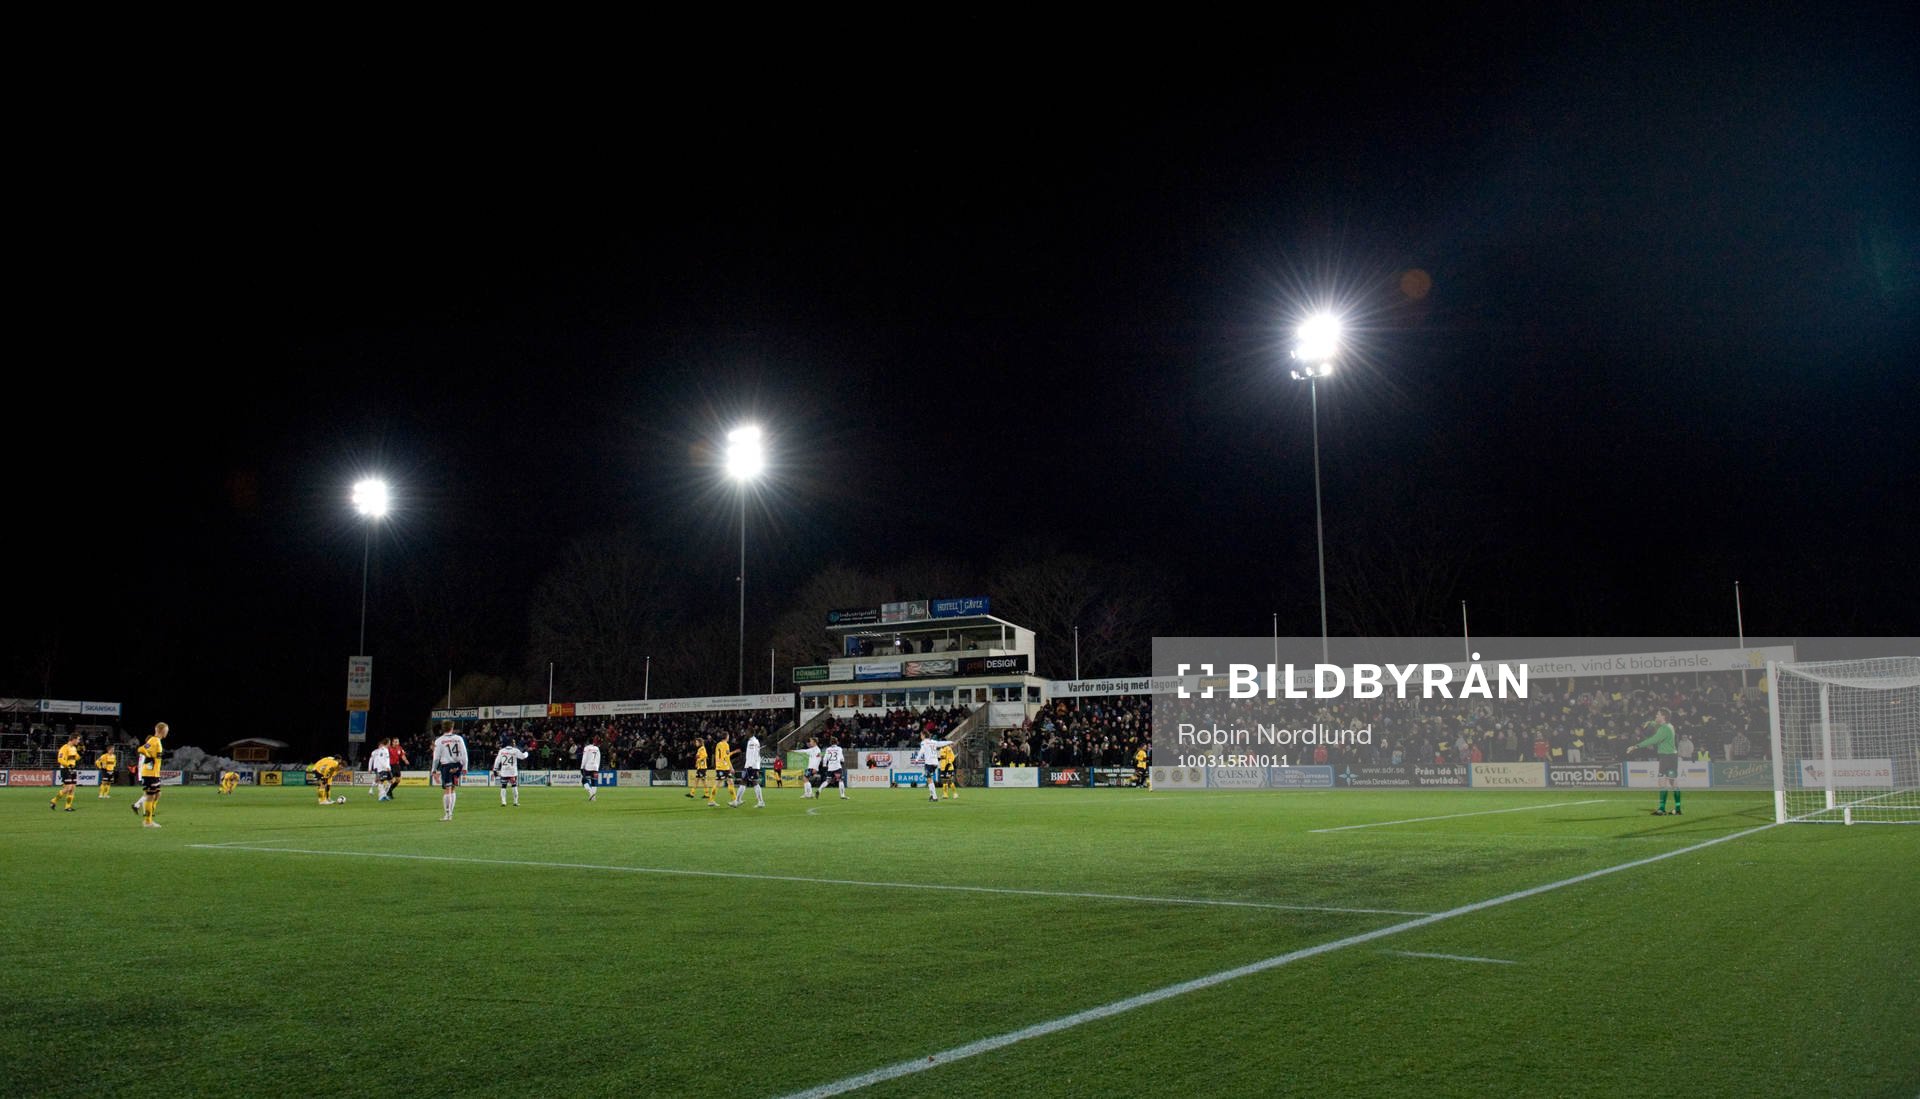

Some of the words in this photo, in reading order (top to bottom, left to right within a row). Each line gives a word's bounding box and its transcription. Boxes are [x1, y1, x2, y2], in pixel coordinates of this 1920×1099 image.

[937, 602, 959, 612] HOTELL
[964, 599, 983, 609] GÄVLE
[986, 659, 1017, 669] DESIGN
[1528, 663, 1577, 674] vatten,
[1581, 658, 1613, 671] vind
[1615, 657, 1626, 670] &
[1630, 654, 1713, 670] biobränsle.
[1068, 682, 1095, 692] Varför
[1096, 681, 1114, 693] nöja
[1115, 680, 1129, 692] sig
[1130, 679, 1150, 690] med
[1151, 678, 1183, 692] lagom?
[85, 704, 116, 712] SKANSKA
[446, 743, 459, 757] 14
[501, 755, 514, 766] 24
[829, 751, 838, 761] 23
[1050, 771, 1080, 781] BRIXX
[1217, 769, 1258, 779] CAESAR
[1415, 767, 1434, 775] Från
[1454, 767, 1466, 775] till
[1583, 769, 1619, 781] blom
[10, 773, 52, 783] GEVALIA
